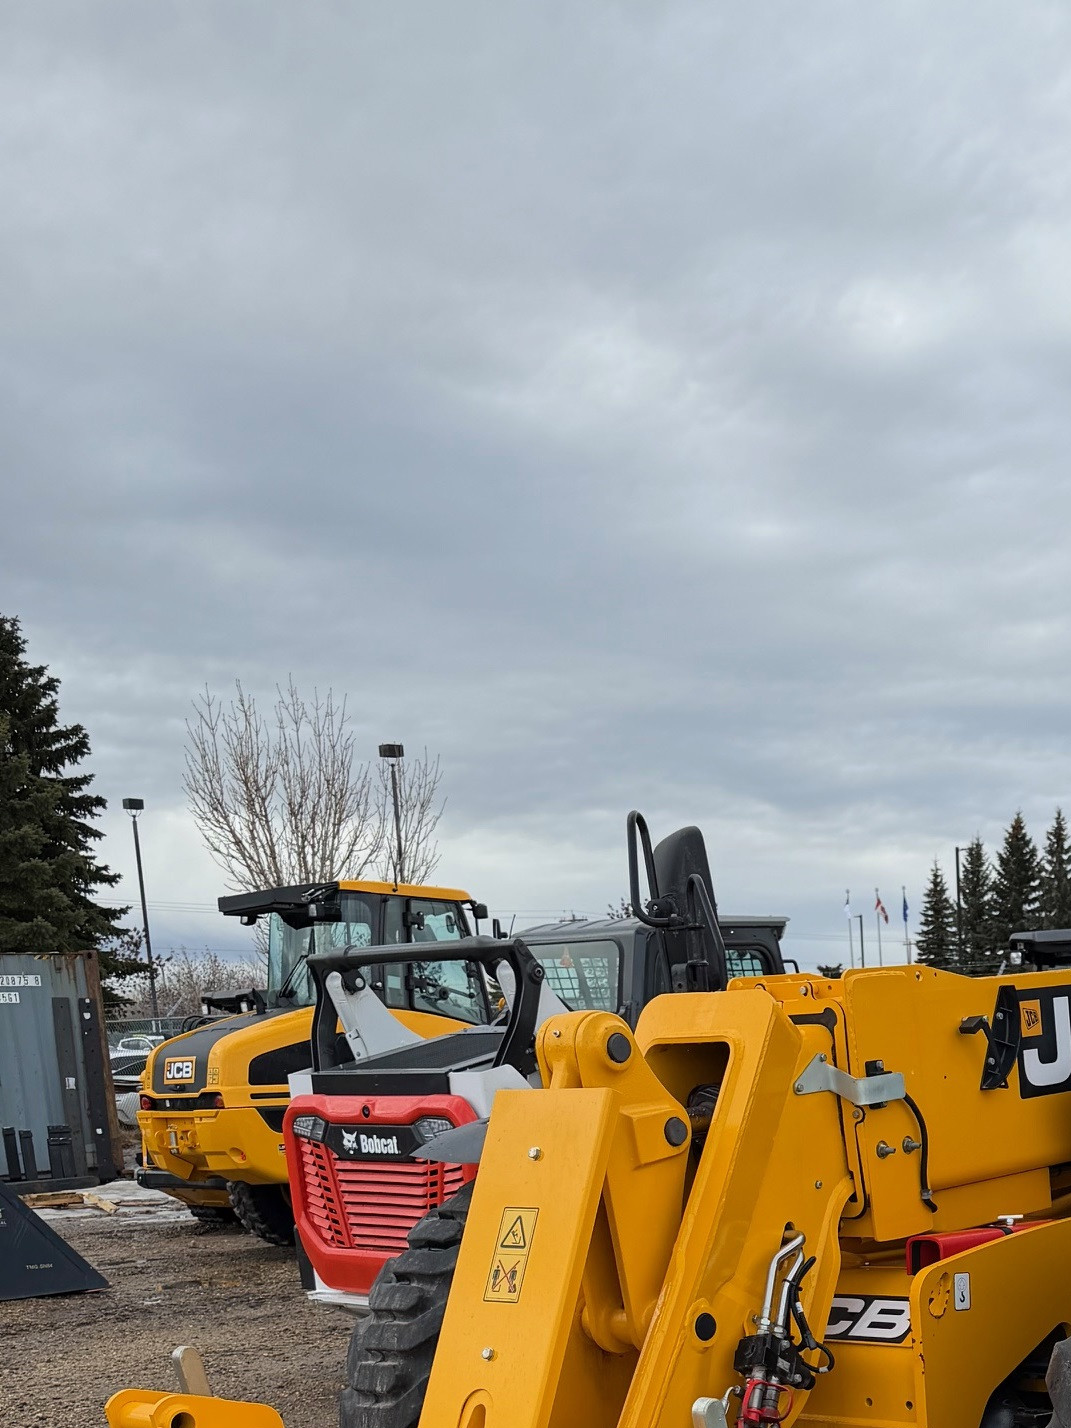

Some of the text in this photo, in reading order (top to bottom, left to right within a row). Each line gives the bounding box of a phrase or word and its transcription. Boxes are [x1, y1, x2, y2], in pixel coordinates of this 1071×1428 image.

[34, 976, 40, 985] 8
[166, 1061, 193, 1079] JCB
[360, 1134, 399, 1154] Bobcat
[824, 1297, 911, 1339] CB
